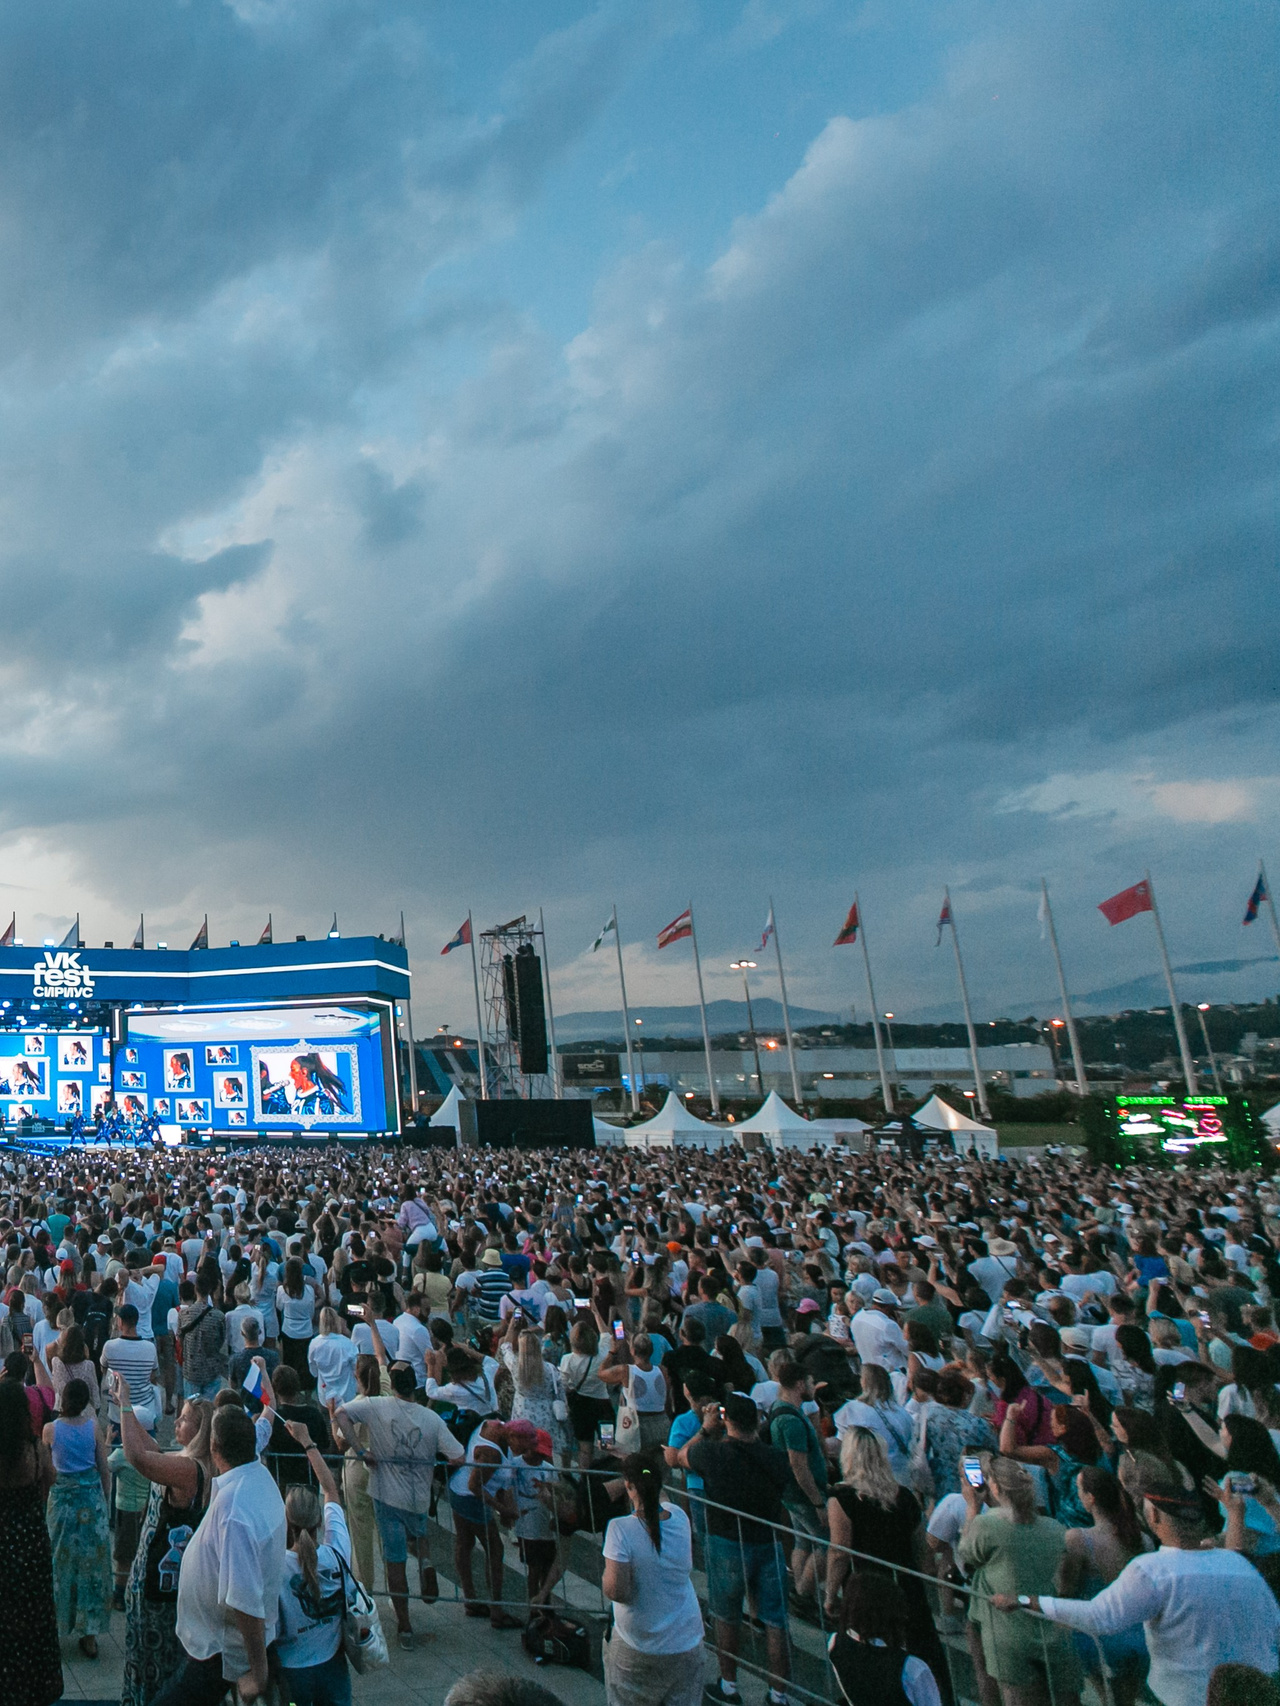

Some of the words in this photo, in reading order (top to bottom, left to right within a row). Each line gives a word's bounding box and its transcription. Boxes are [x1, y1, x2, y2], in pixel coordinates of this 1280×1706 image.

[44, 952, 81, 969] VK
[33, 962, 95, 987] fest
[33, 986, 94, 998] СИРИУС
